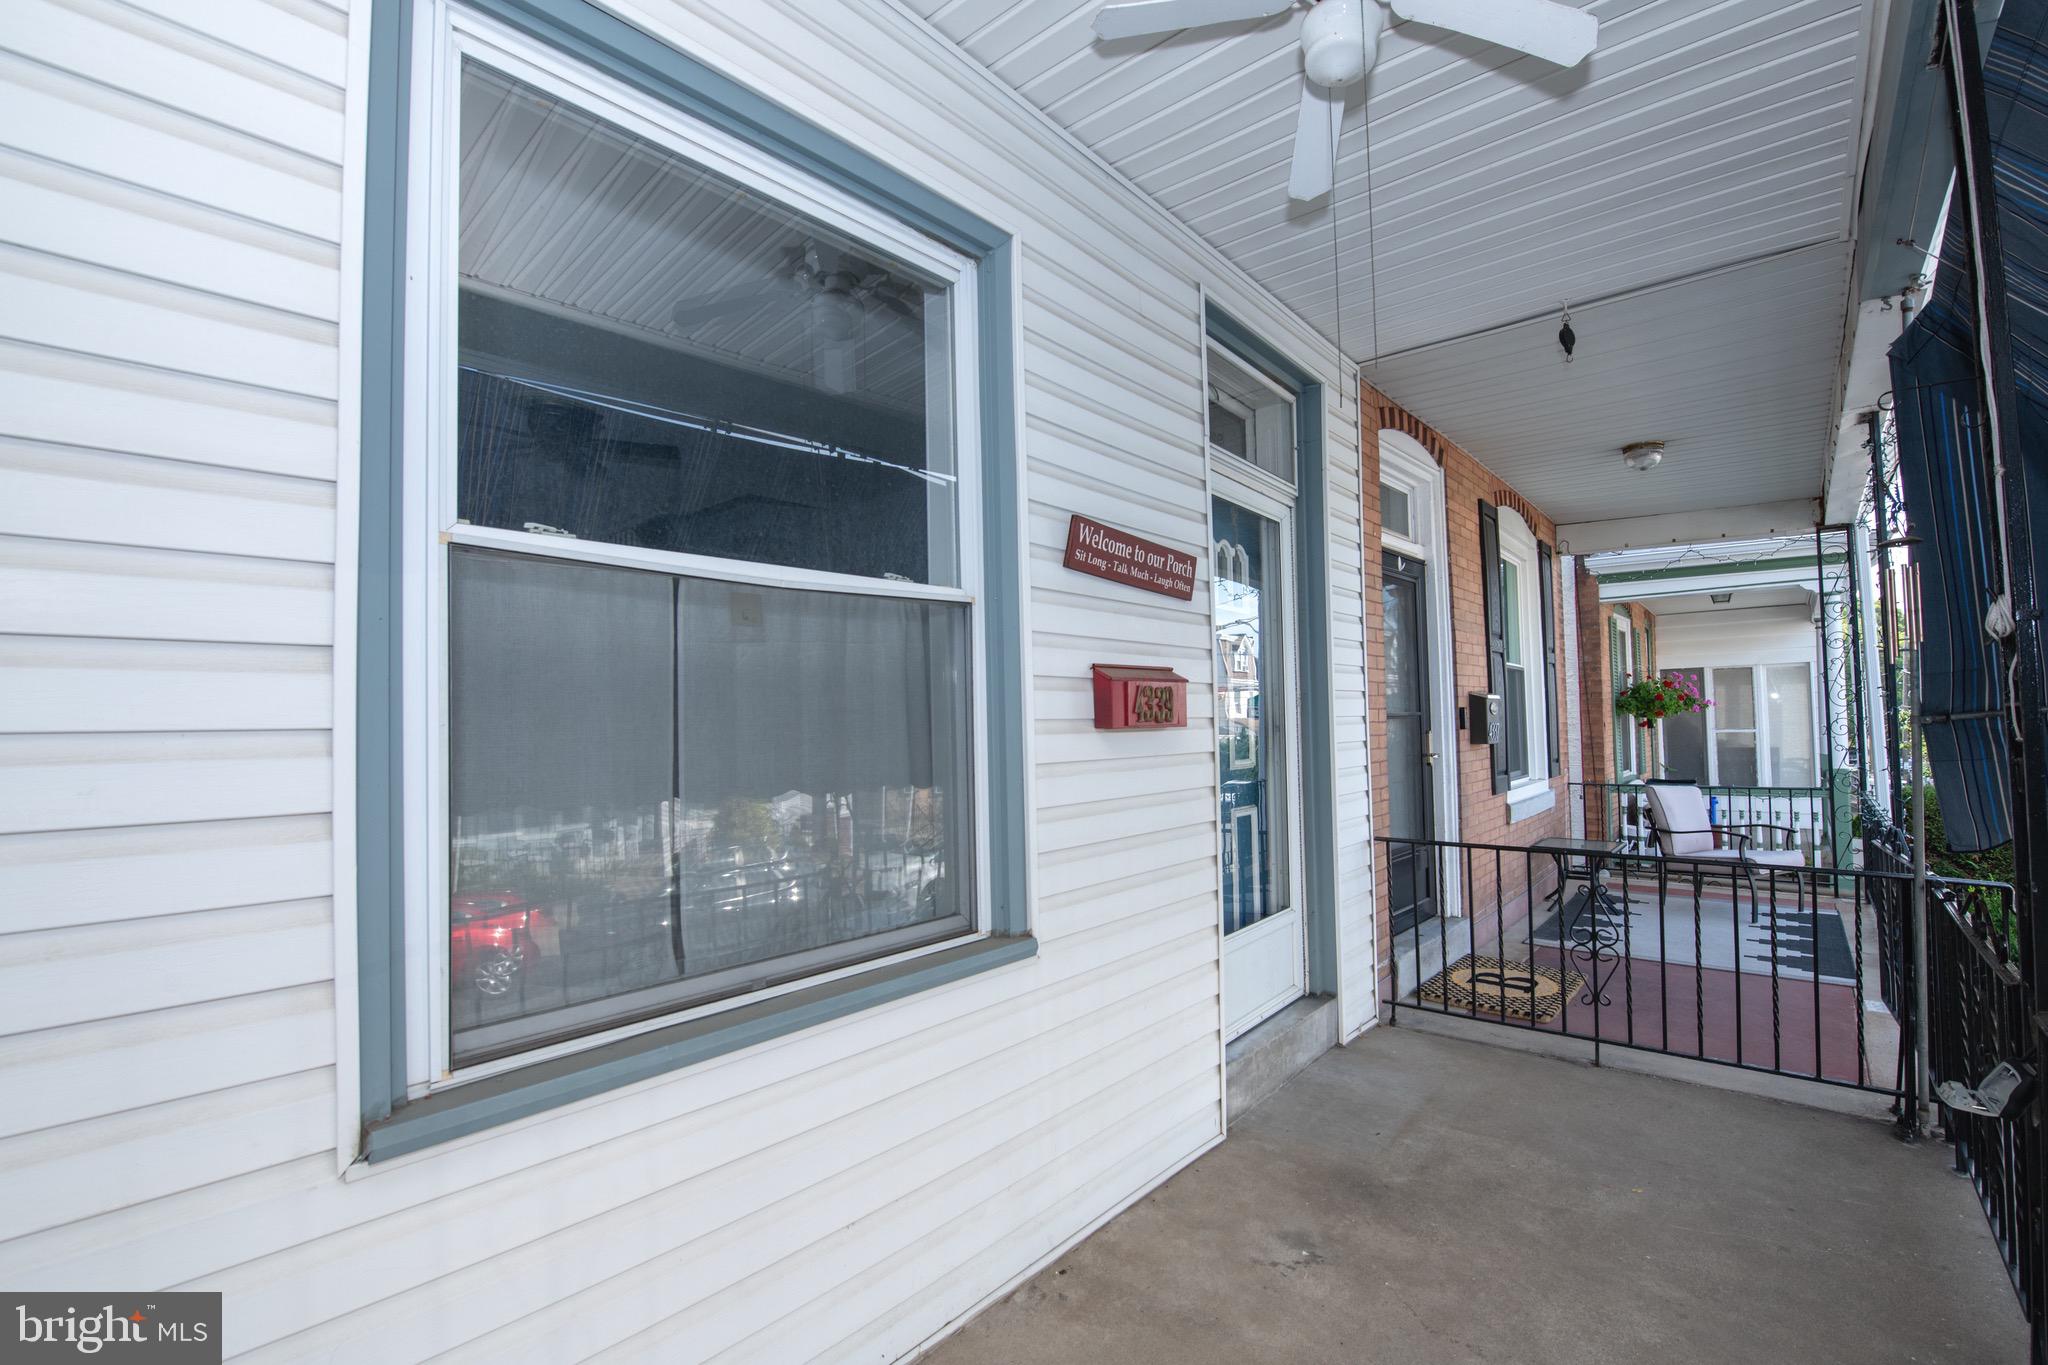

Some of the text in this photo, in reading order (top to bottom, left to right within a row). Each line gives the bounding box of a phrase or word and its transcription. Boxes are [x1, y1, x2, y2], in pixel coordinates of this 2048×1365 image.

[1074, 549, 1087, 562] Sit
[1087, 553, 1107, 571] Long
[1113, 560, 1128, 575] Talk
[1130, 566, 1149, 581] Much
[1154, 573, 1173, 589] Laugh
[1173, 580, 1191, 593] Often
[1079, 523, 1193, 578] Welcome to our Porch
[1132, 685, 1174, 723] 4339
[1466, 972, 1538, 993] B
